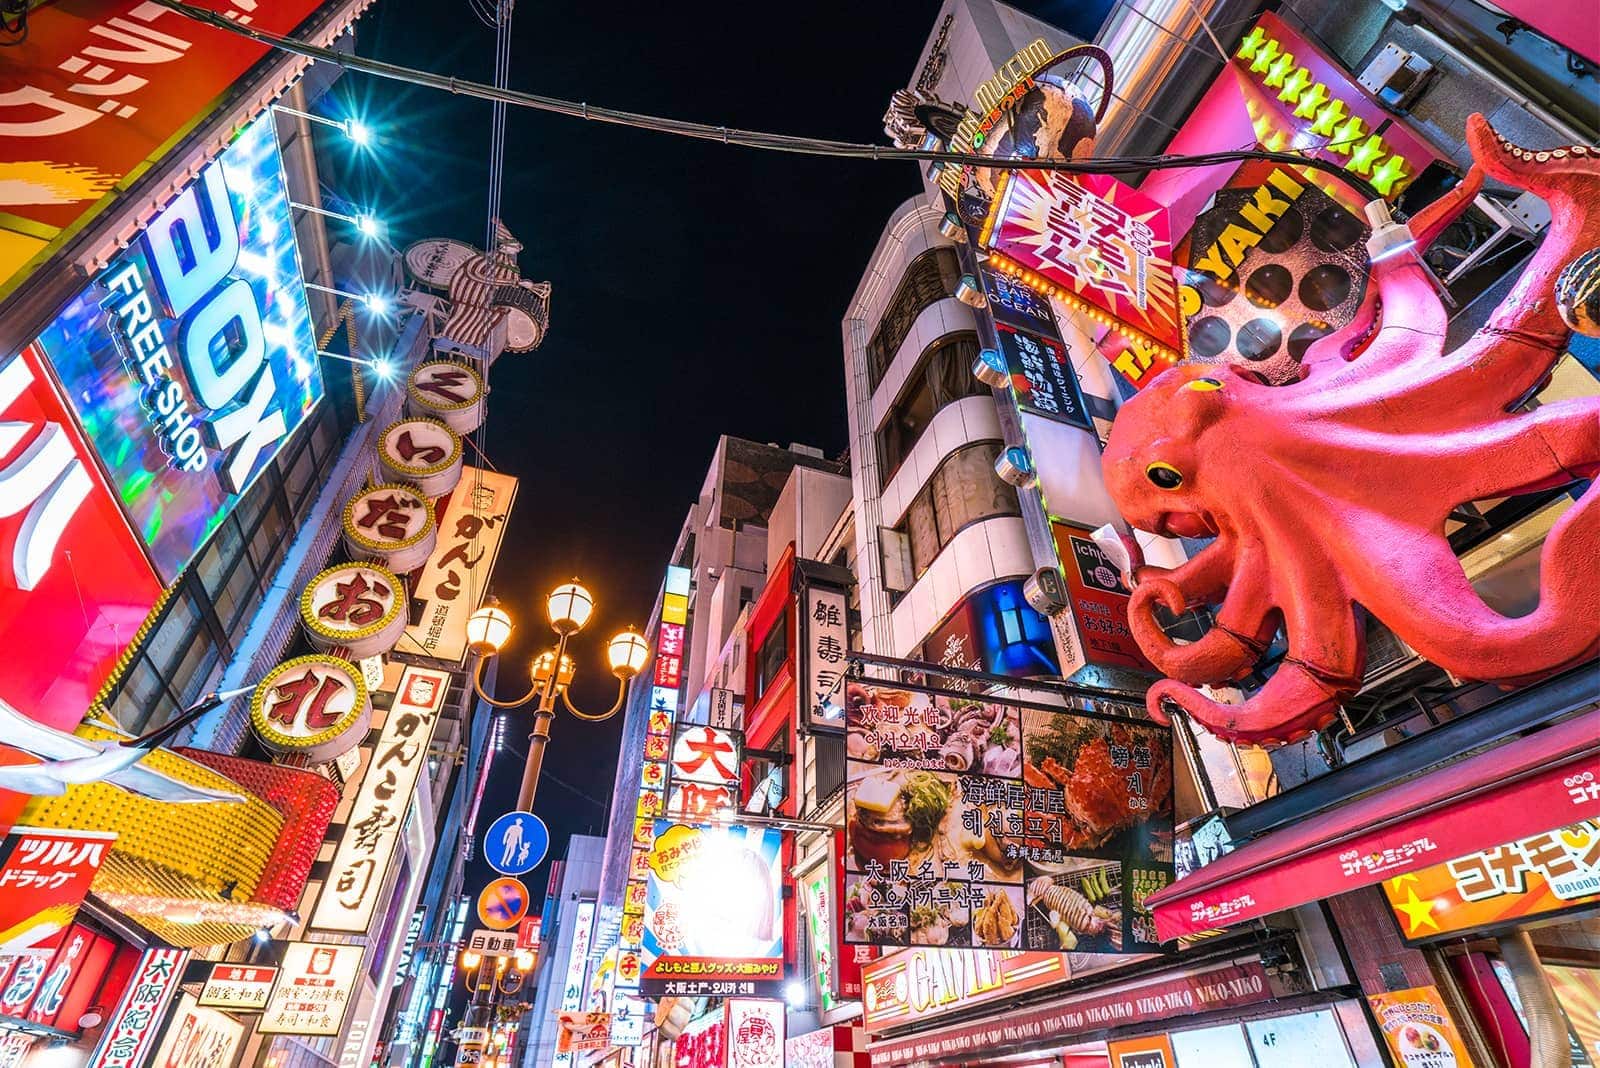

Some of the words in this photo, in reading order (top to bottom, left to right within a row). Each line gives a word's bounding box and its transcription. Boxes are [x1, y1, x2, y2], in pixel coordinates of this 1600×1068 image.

[975, 38, 1053, 113] MUSEUM
[959, 76, 1035, 188] DOONBORI
[1113, 168, 1305, 381] TAOYAKI
[988, 294, 1050, 320] OCEAN
[106, 262, 173, 384] FREE
[157, 380, 208, 472] SHOP
[437, 513, 505, 601] がんこ
[860, 704, 941, 726] 欢迎光临
[865, 731, 943, 751] 어서오세요
[962, 809, 1063, 844] 해선호프집
[19, 838, 105, 869] ツルハ
[0, 869, 76, 889] ドラッグ
[865, 860, 985, 881] 大阪名产物
[868, 887, 986, 910] 오오사까특산품
[393, 910, 424, 988] TSUTAYA
[471, 936, 516, 952] 自動車
[1196, 975, 1263, 1004] NIKO-NIKO
[104, 958, 173, 1068] 大阪紀念
[1085, 1001, 1133, 1024] NIKO-NIKO
[1137, 990, 1193, 1016] NIKO-NIKO
[1043, 1011, 1084, 1033] NIKO-NIKO
[1262, 1033, 1277, 1047] 4F
